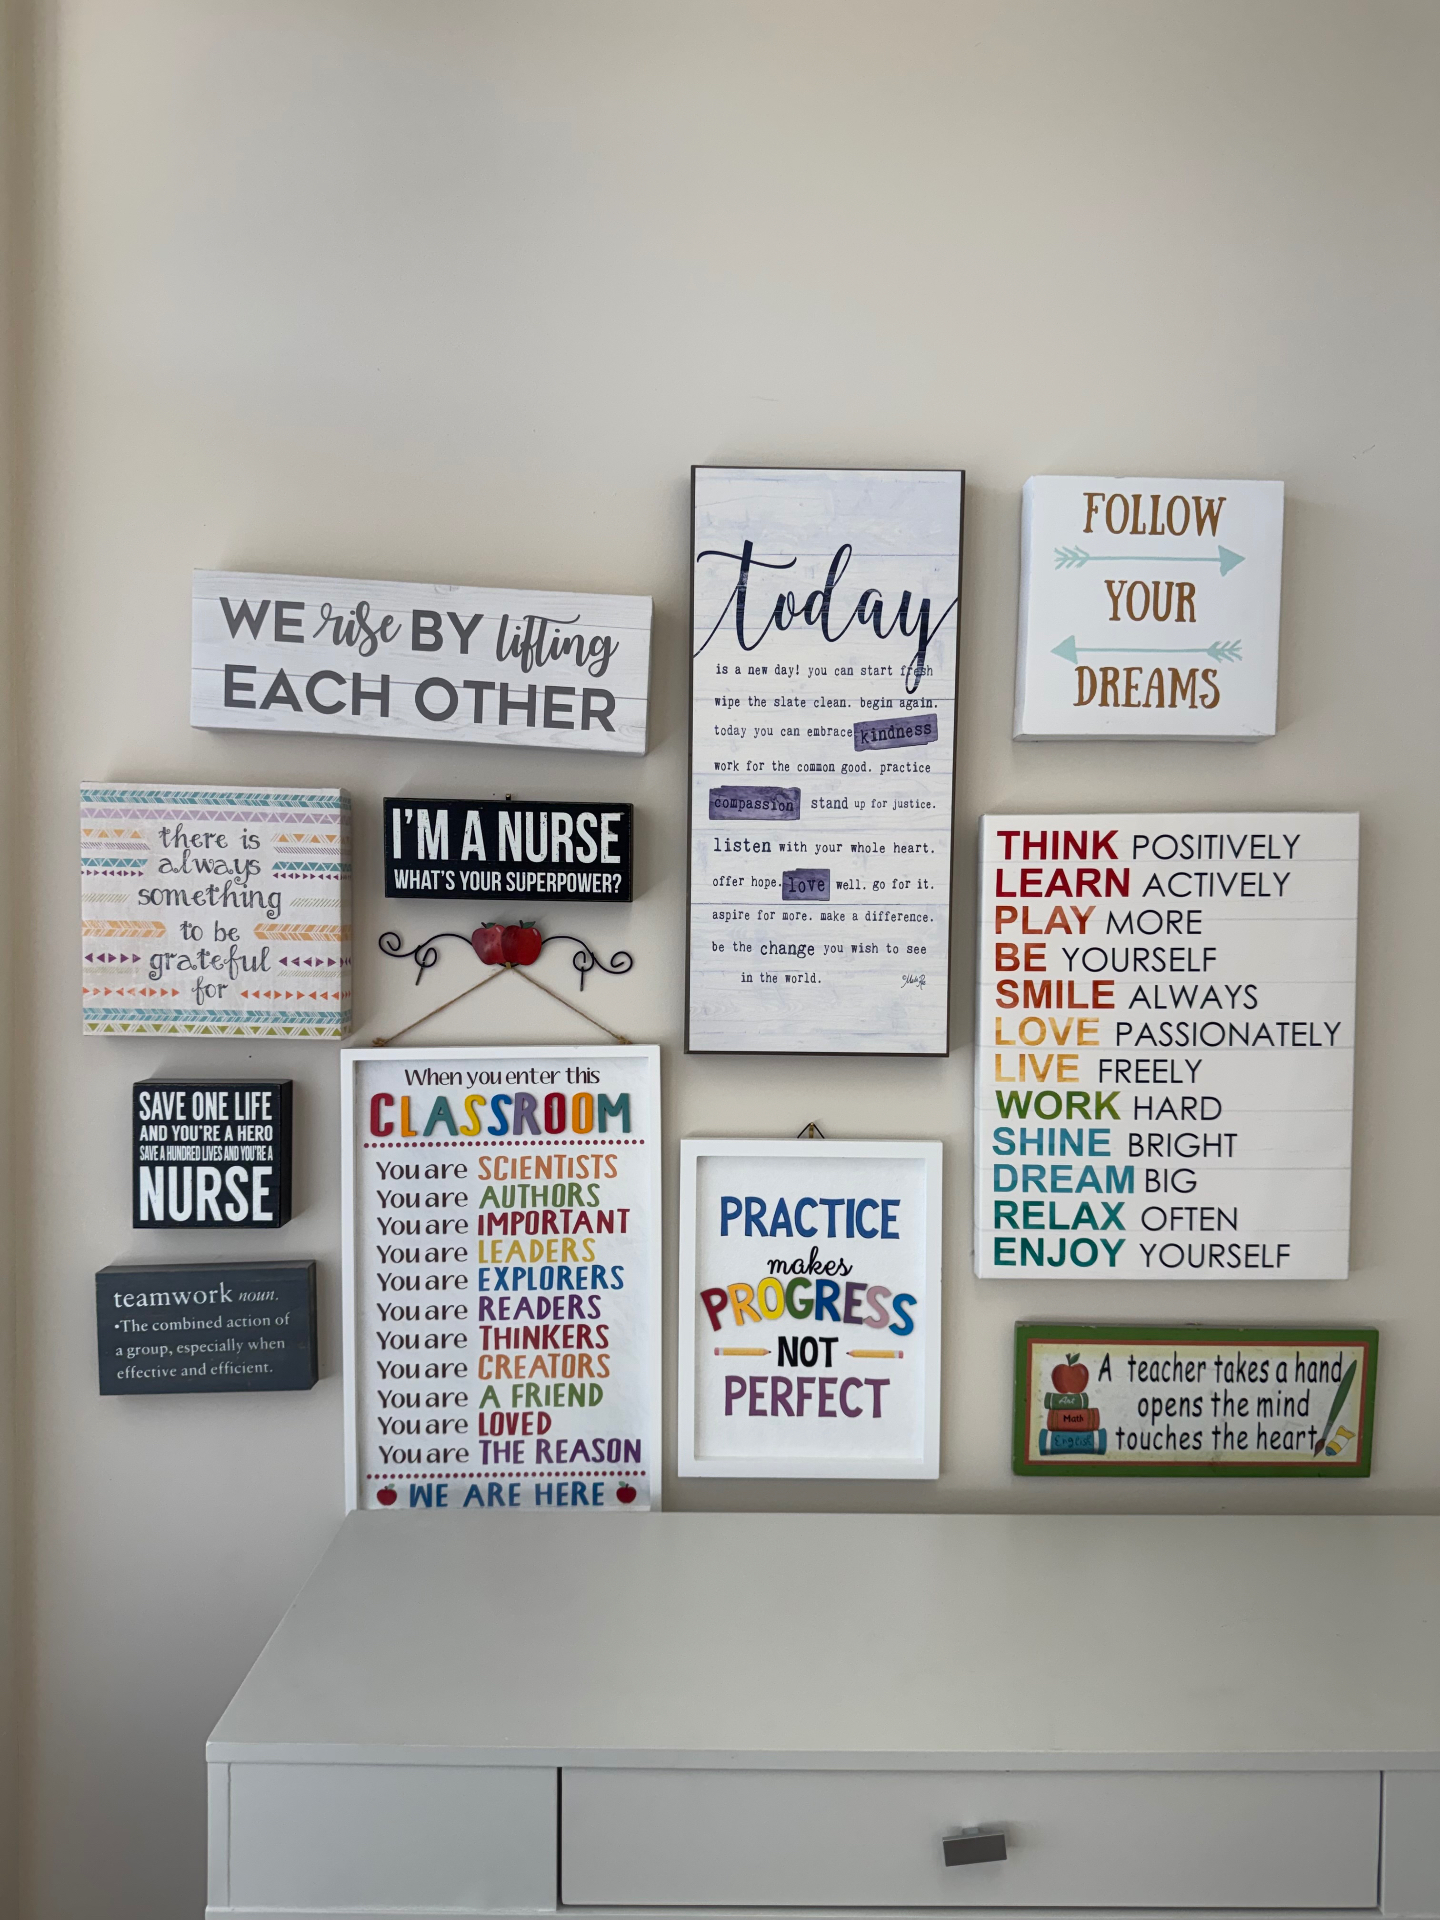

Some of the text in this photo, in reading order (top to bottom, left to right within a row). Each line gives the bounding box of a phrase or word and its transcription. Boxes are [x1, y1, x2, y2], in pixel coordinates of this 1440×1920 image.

[1083, 492, 1227, 537] FOLLOW
[1104, 580, 1196, 622] YOUR
[693, 540, 958, 694] today
[219, 597, 619, 677] WE rise BY lifting
[224, 663, 616, 732] EACH OTHER
[1073, 666, 1220, 709] DREAMS
[715, 697, 938, 710] wipe the slate clean. begin again.
[715, 724, 932, 744] today you can embrace kindness
[714, 761, 931, 775] work for the common good. practice
[715, 798, 936, 812] compassion stand up for justice.
[158, 823, 260, 849] there is
[392, 807, 621, 863] I'M A NURSE
[714, 838, 935, 855] listen with your whole heart.
[997, 830, 1300, 860] THINK POSITIVELY
[158, 849, 261, 885] always
[394, 869, 622, 893] WHAT'S YOUR SUPERPOWER?
[995, 867, 1290, 898] LEARN ACTIVELY
[138, 880, 281, 919] something
[180, 921, 240, 941] to be
[995, 906, 1203, 935] PLAY MORE
[149, 945, 271, 980] grateful
[995, 943, 1217, 972] BE YOURSELF
[192, 976, 228, 1005] for
[741, 973, 821, 983] in the world.
[995, 980, 1258, 1010] SMILE ALWAYS
[995, 1017, 1341, 1047] LOVE PASSIONATELY
[404, 1067, 600, 1089] When you enter this
[995, 1054, 1203, 1084] LIVE FREELY
[139, 1091, 272, 1121] SAVE ONE LIFE
[369, 1092, 631, 1138] CLASSROOM
[995, 1091, 1222, 1121] WORK HARD
[140, 1125, 273, 1142] AND YOU'RE A HERO
[992, 1127, 1238, 1158] SHINE BRIGHT
[140, 1145, 272, 1161] SAVE A HUNDRED LIVES AND YOU'RE A
[376, 1154, 618, 1181] You are SCIENTISTS
[140, 1166, 273, 1221] NURSE
[993, 1164, 1198, 1194] DREAM BIG
[376, 1183, 600, 1209] You are AUTHORS
[377, 1209, 630, 1236] You are IMPORTANT
[720, 1196, 900, 1239] PRACTICE
[993, 1200, 1238, 1232] RELAX OFTEN
[767, 1246, 853, 1277] makes
[993, 1237, 1290, 1269] ENJOY YOURSELF
[114, 1282, 279, 1308] teamwork noun.
[700, 1277, 917, 1336] PROGRESS
[115, 1338, 285, 1358] a group, especially when
[778, 1336, 839, 1368] NOT
[117, 1362, 273, 1379] effective and efficient.
[377, 1353, 610, 1380] You are CREATORS
[1098, 1351, 1342, 1383] A teacher takes a hand
[377, 1382, 604, 1409] You are A FRIEND
[725, 1376, 890, 1418] PERFECT
[1138, 1389, 1310, 1425] opens the mind
[378, 1412, 552, 1436] You are LOVED
[1063, 1414, 1084, 1423] Math
[379, 1438, 641, 1465] You are THE REASON
[1115, 1423, 1318, 1451] touches the heart
[409, 1482, 605, 1508] WE ARE HERE
